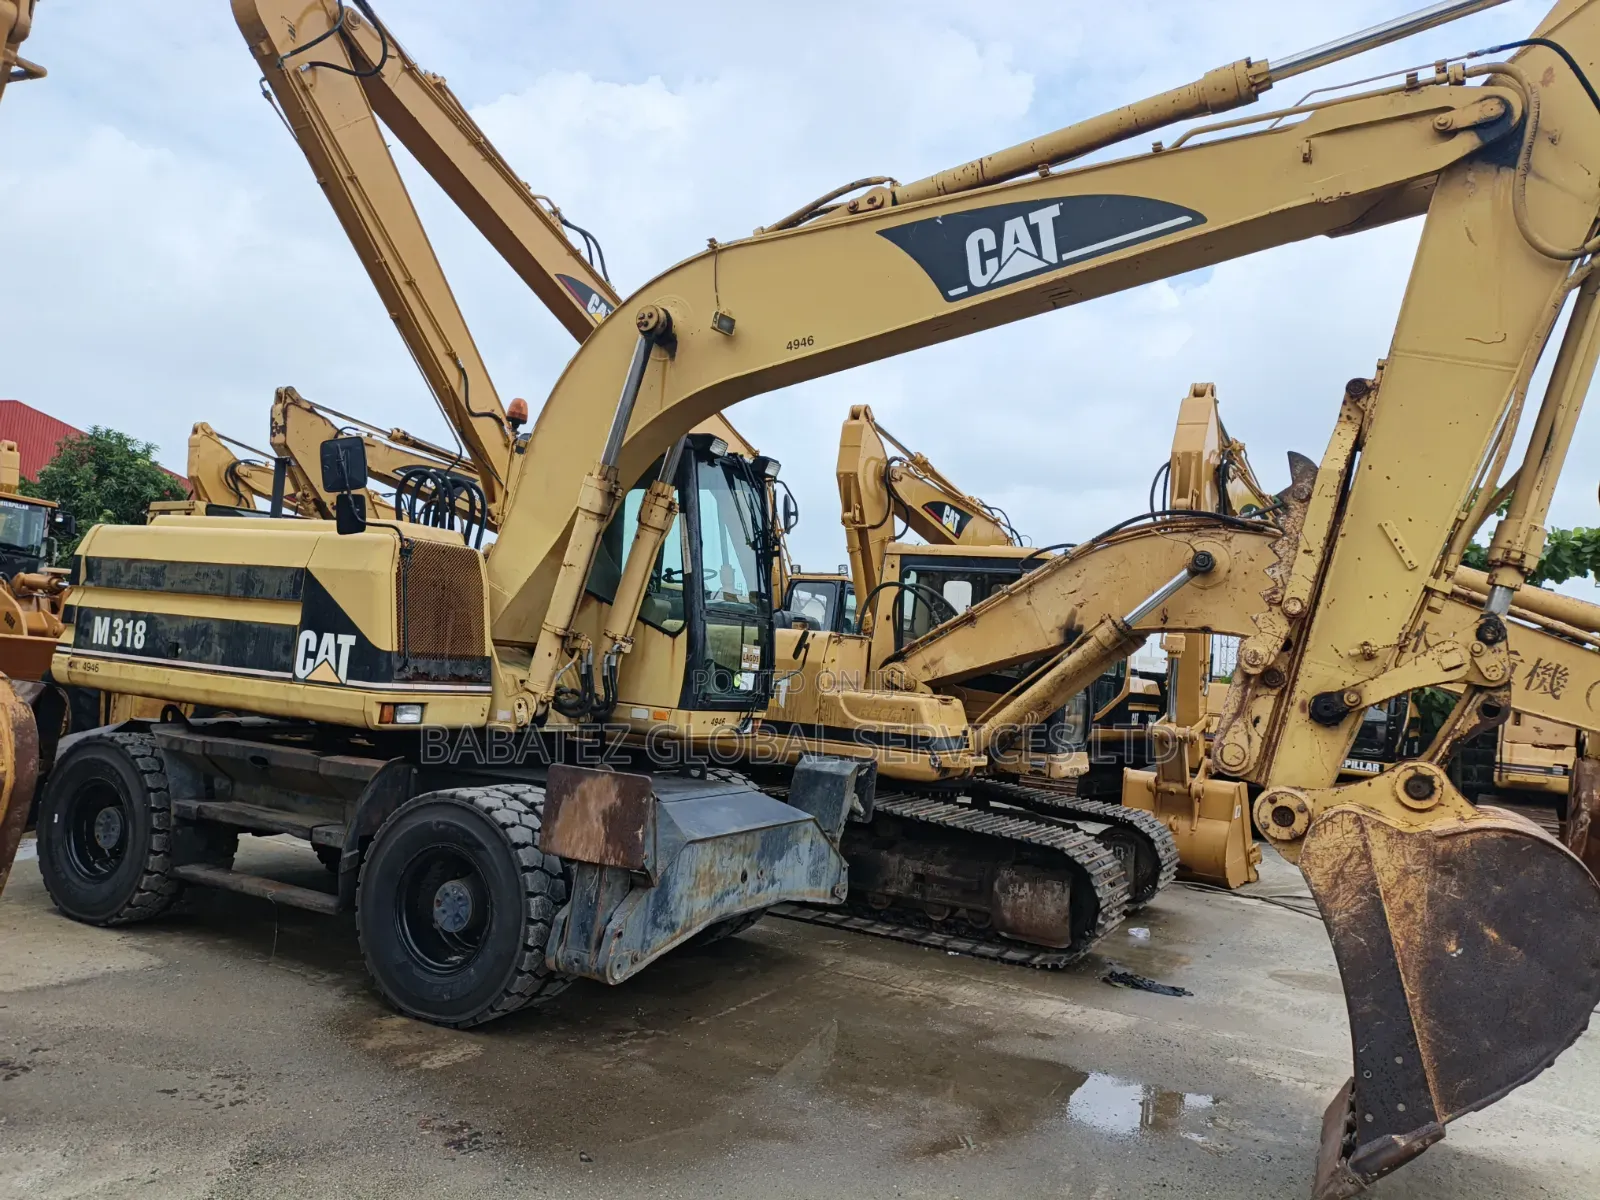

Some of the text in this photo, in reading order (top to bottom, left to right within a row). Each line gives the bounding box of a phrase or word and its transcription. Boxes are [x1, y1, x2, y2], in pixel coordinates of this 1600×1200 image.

[965, 203, 1061, 287] CAT
[786, 335, 815, 351] 4946
[942, 505, 960, 535] CAT
[92, 616, 147, 649] M318
[82, 662, 99, 673] 4946
[295, 630, 356, 685] CAT
